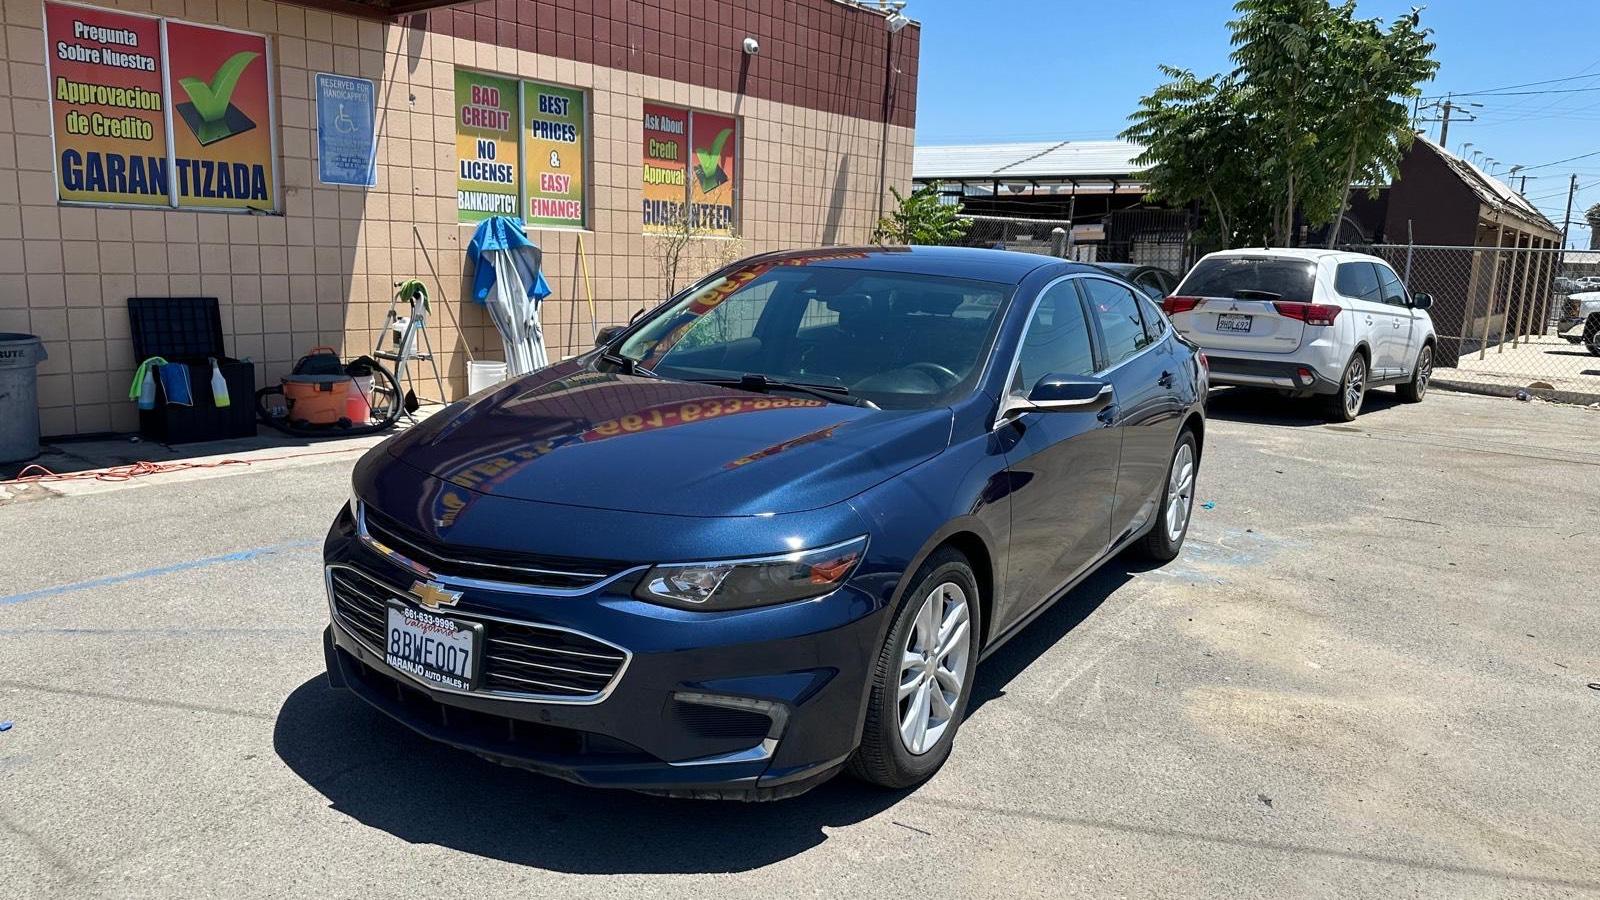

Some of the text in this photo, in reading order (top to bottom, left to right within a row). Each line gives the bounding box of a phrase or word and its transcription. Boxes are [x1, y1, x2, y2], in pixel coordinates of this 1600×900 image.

[74, 21, 137, 46] Pregunta
[57, 42, 155, 71] Sobre Nuestra
[57, 77, 161, 111] Approvacion
[320, 78, 369, 92] RESERVED FOR
[323, 88, 369, 102] HANDICAPPED
[471, 85, 499, 107] BAD
[539, 94, 569, 116] BEST
[66, 111, 153, 141] de Credito
[461, 106, 510, 130] CREDIT
[644, 113, 684, 135] Ask About
[532, 119, 576, 142] PRICES
[477, 139, 496, 160] NO
[549, 150, 561, 168] &
[649, 138, 678, 160] Credit
[61, 148, 268, 200] GARANTIZADA
[460, 160, 513, 183] LICENSE
[643, 163, 685, 186] Approval
[540, 174, 570, 193] EASY
[457, 191, 517, 214] BANKRUPTCY
[530, 198, 581, 218] FINANCE
[404, 608, 455, 630] 661-633-9999
[390, 628, 469, 678] 8BWE007
[387, 654, 424, 675] NARANJO
[424, 670, 441, 682] AUTO
[442, 675, 463, 688] SALES
